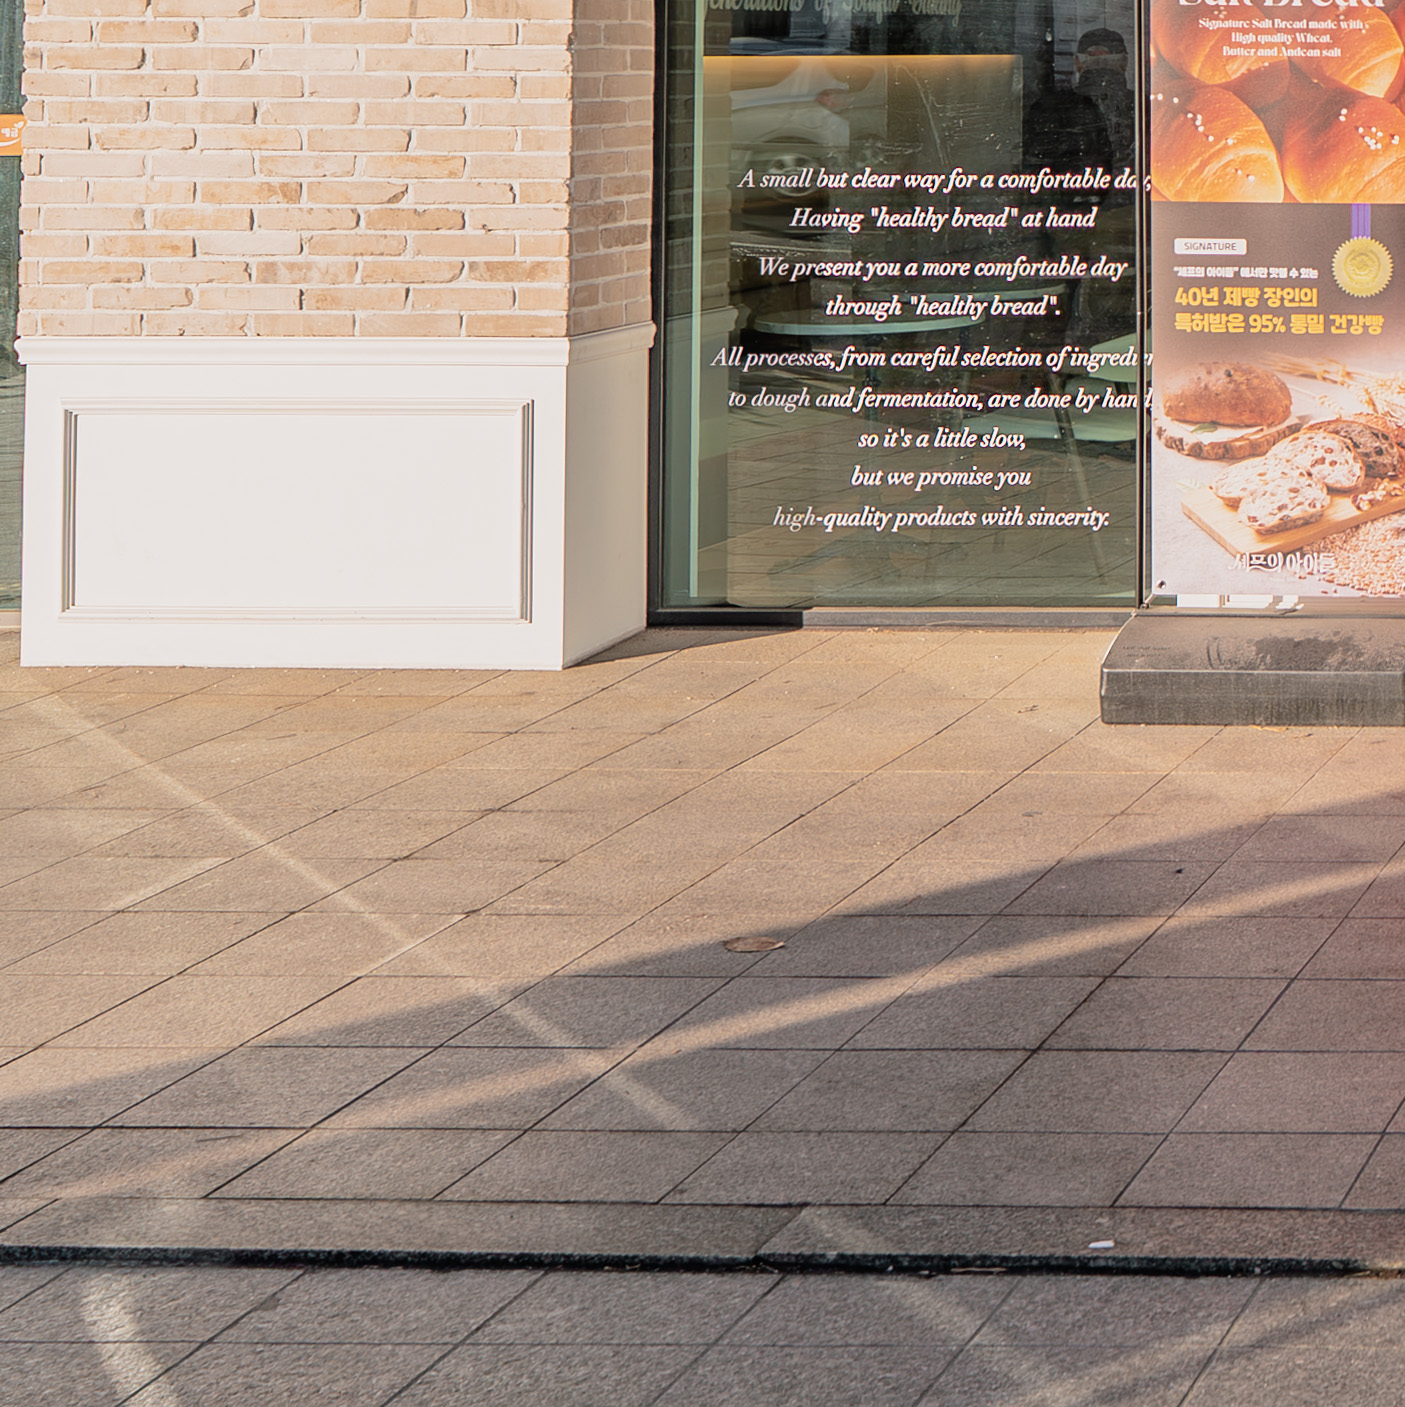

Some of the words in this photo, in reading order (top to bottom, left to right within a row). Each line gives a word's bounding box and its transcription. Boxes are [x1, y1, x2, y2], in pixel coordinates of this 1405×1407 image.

[1198, 17, 1251, 30] Signature
[1252, 18, 1273, 29] Salt
[1274, 18, 1307, 29] Bread
[1308, 18, 1338, 29] made
[1223, 46, 1257, 57] Butter
[1257, 46, 1278, 57] and
[1279, 46, 1321, 57] Andean
[1322, 46, 1342, 57] salt
[1231, 32, 1256, 44] High
[1257, 32, 1294, 45] quality
[736, 168, 756, 188] A
[759, 167, 814, 188] small
[816, 167, 850, 189] but
[851, 166, 902, 188] clear
[903, 174, 945, 194] way
[942, 167, 979, 194] for
[979, 174, 995, 189] a
[997, 167, 1112, 194] comfortable
[789, 207, 865, 234] Having
[870, 205, 950, 233] "healthy
[951, 206, 1019, 229] bread"
[1021, 211, 1044, 228] at
[1045, 206, 1098, 228] hand
[1184, 241, 1237, 251] SIGNATURE
[758, 256, 790, 276] We
[789, 260, 864, 282] present
[863, 262, 901, 282] you
[903, 262, 919, 276] a
[921, 262, 971, 277] more
[973, 255, 1088, 282] comfortable
[1090, 255, 1129, 282] day
[1289, 268, 1299, 279] 수
[825, 294, 902, 322] through
[908, 294, 989, 322] "healthy
[990, 294, 1061, 316] bread".
[1175, 286, 1220, 307] 40년
[1223, 286, 1261, 307] 제빵
[1263, 287, 1318, 308] 장인의
[1174, 312, 1246, 333] 특허받은
[1248, 313, 1287, 334] 95%
[1289, 313, 1326, 335] 통밀
[1329, 313, 1385, 335] 건강빵
[709, 346, 744, 367] All
[740, 346, 839, 373] processes,
[836, 345, 887, 372] from
[890, 345, 961, 372] careful
[960, 345, 1042, 367] selection
[1045, 345, 1070, 372] of
[728, 391, 747, 407] to
[750, 386, 811, 414] dough
[815, 386, 856, 413] and
[851, 386, 984, 413] fermentation,
[987, 394, 1022, 408] are
[1023, 387, 1072, 409] done
[1074, 387, 1100, 414] by
[857, 434, 879, 448] so
[883, 427, 913, 448] it's
[915, 433, 930, 448] a
[933, 426, 978, 448] little
[979, 426, 1026, 451] slow,
[851, 464, 884, 486] but
[887, 472, 915, 486] we
[912, 465, 994, 492] promise
[993, 471, 1032, 491] you
[773, 505, 893, 533] high-quality
[891, 505, 978, 533] products
[981, 505, 1024, 526] with
[1026, 506, 1110, 532] sincerity.
